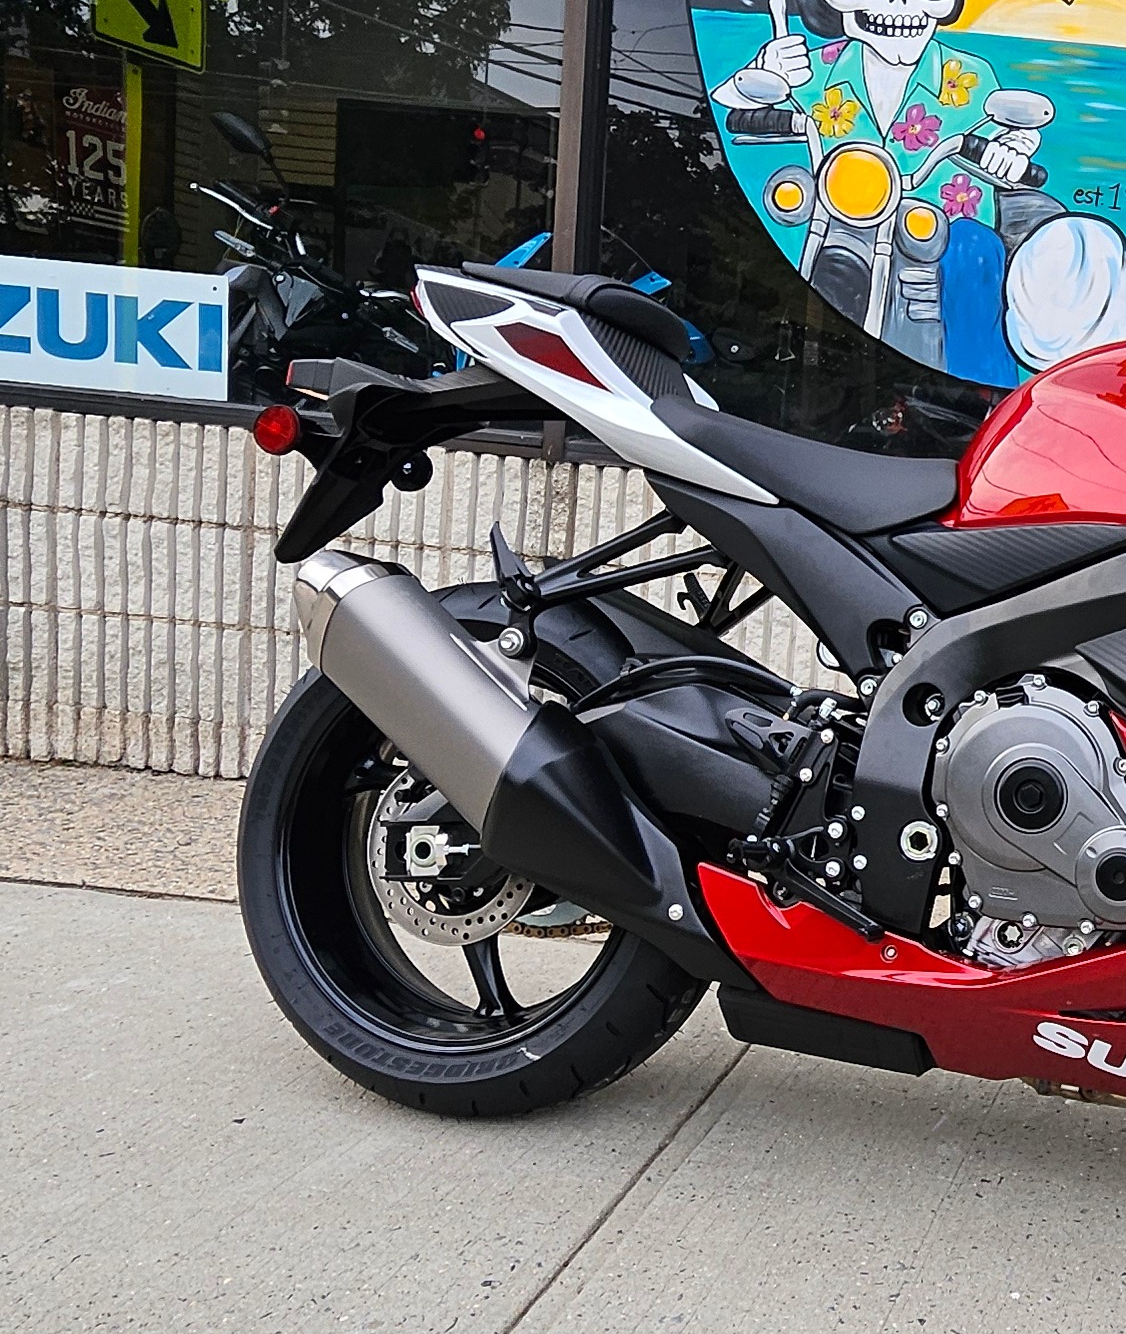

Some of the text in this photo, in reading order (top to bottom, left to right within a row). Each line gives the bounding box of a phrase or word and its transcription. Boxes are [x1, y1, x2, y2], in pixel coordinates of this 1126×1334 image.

[62, 88, 128, 124] Indian
[66, 130, 127, 186] 125
[67, 176, 129, 209] YEARS
[1073, 186, 1104, 207] est.
